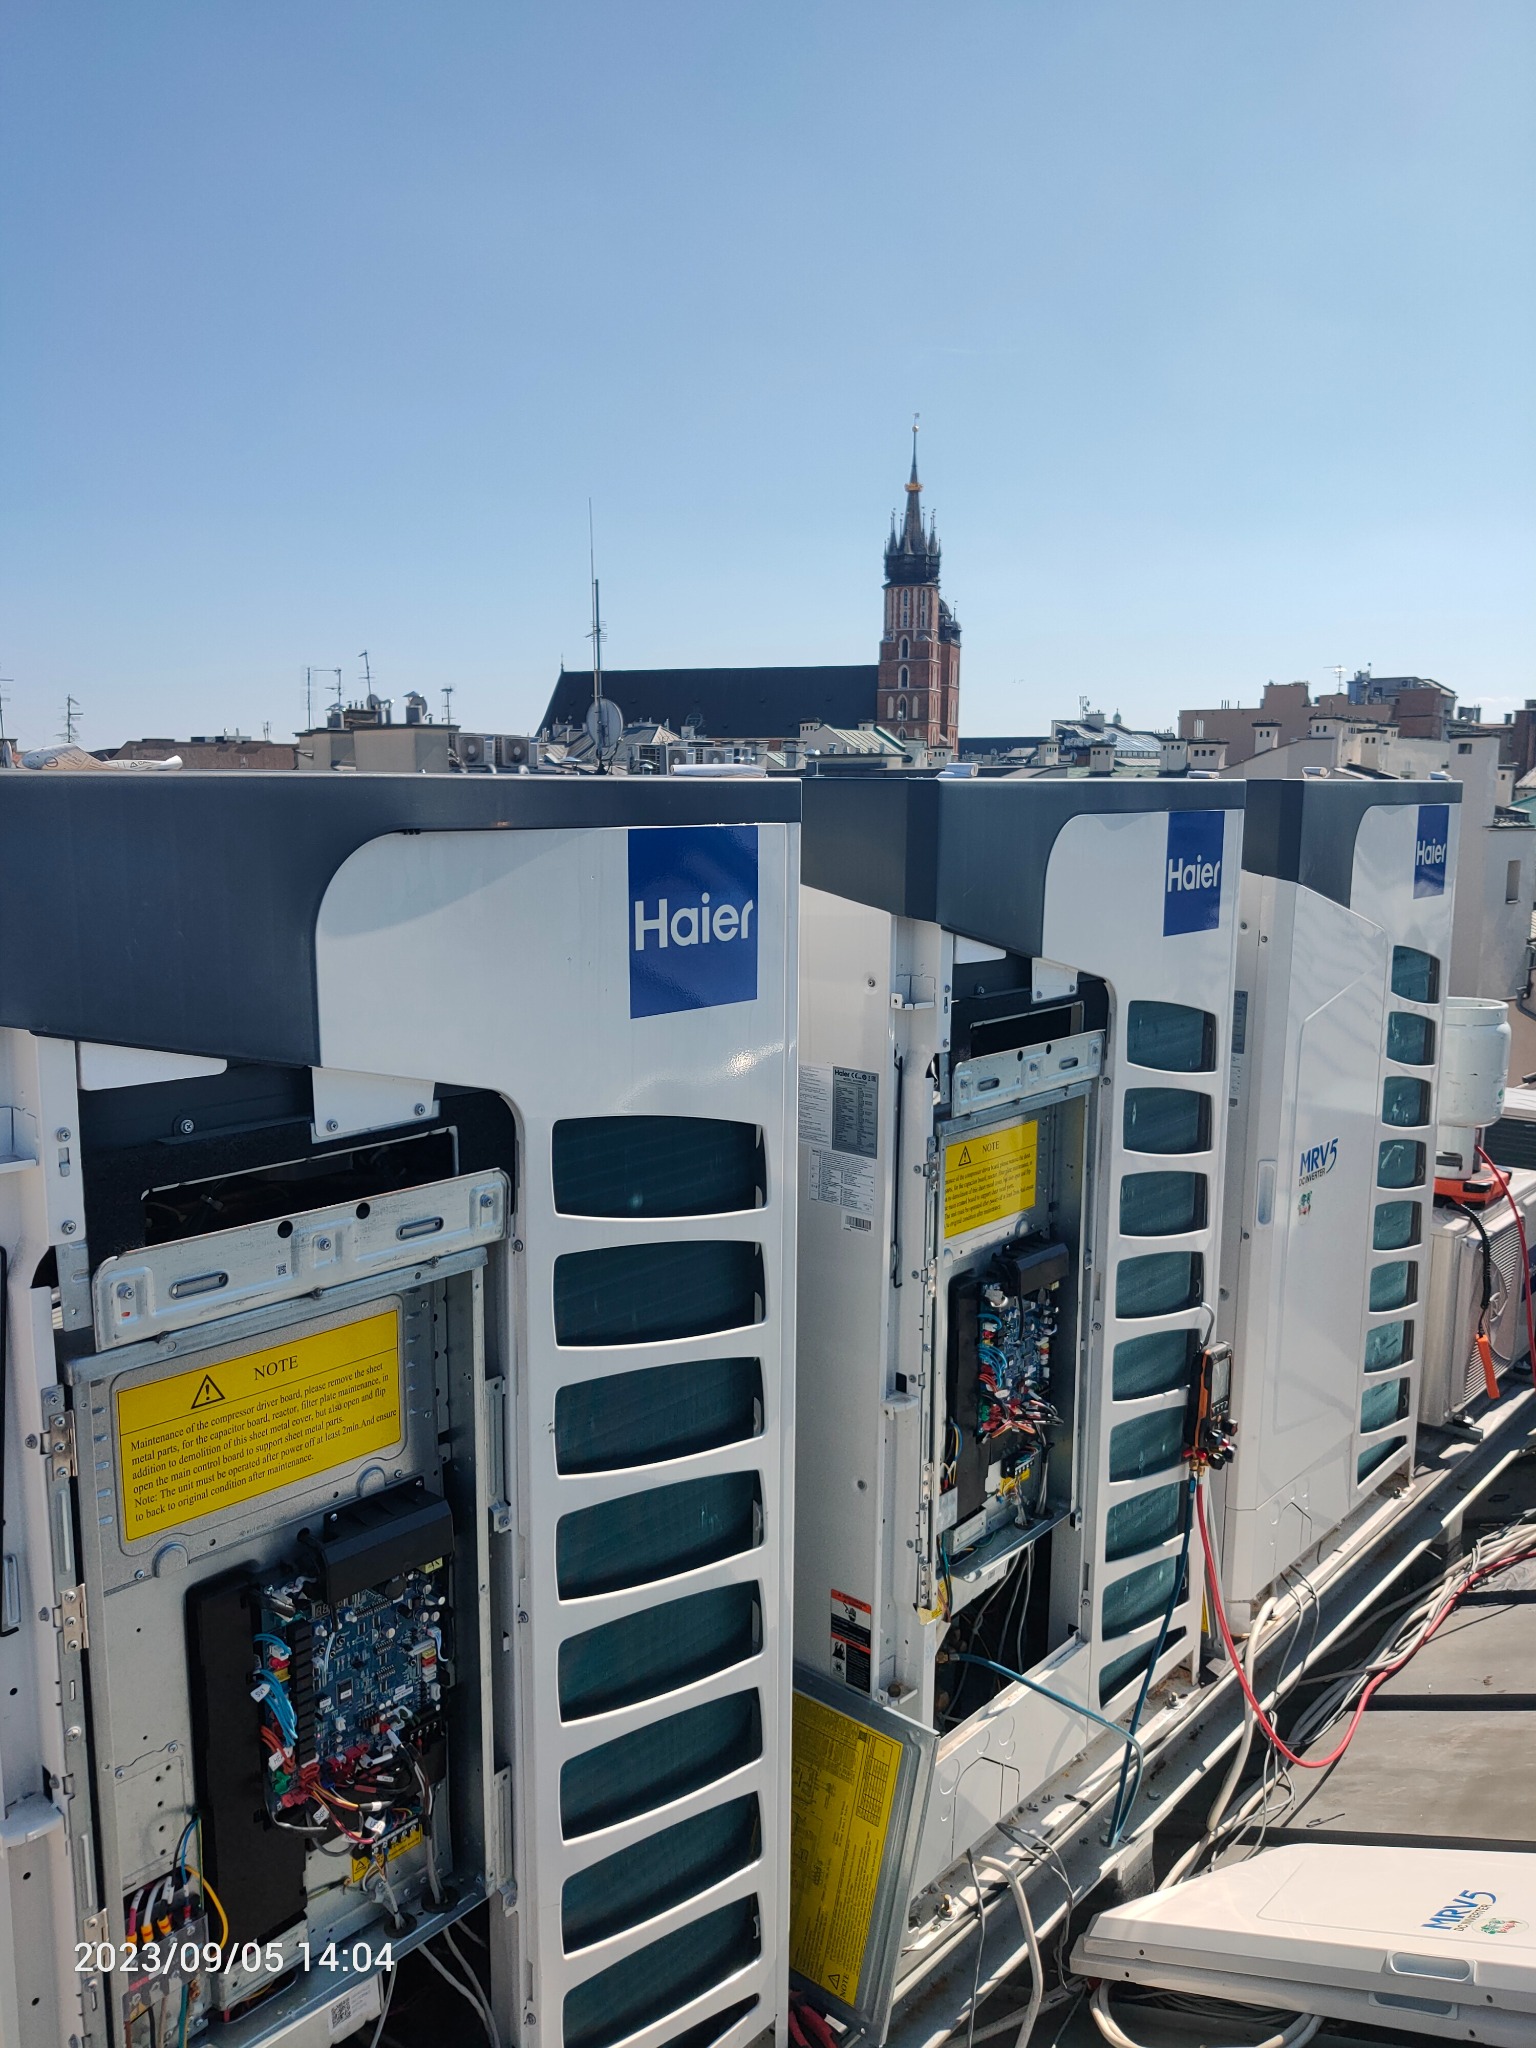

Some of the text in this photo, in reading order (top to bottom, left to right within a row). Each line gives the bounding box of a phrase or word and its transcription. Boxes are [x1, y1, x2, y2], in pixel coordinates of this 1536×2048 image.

[1415, 838, 1447, 866] Haier
[1167, 854, 1221, 892] Haier
[635, 892, 754, 951] Haier
[982, 1140, 1000, 1153] NOTE
[1299, 1138, 1338, 1176] MRV5
[1305, 1167, 1326, 1183] INVERTER
[253, 1354, 299, 1380] NOTE
[130, 1363, 383, 1451] Maintenance of the compressor driver board, please remove the sheet
[131, 1449, 155, 1465] metal
[157, 1445, 180, 1460] parts,
[182, 1439, 194, 1449] for
[195, 1434, 208, 1445] the
[209, 1423, 246, 1440] capacitor
[246, 1412, 271, 1428] board,
[272, 1405, 300, 1420] reactor,
[301, 1398, 319, 1409] filter
[319, 1392, 337, 1406] plate
[337, 1377, 381, 1397] maintenance,
[132, 1387, 386, 1479] addition to demolition of this sheet metal cover, but also open and flip
[133, 1416, 343, 1494] open the main control board to support sheet metal parts.
[134, 1494, 158, 1507] Note:
[159, 1487, 176, 1498] The
[178, 1480, 194, 1493] unit
[195, 1474, 215, 1487] must
[216, 1470, 227, 1479] be
[227, 1456, 261, 1476] operated
[262, 1452, 279, 1463] after
[280, 1443, 304, 1459] power
[304, 1436, 316, 1448] off
[316, 1435, 323, 1444] at
[325, 1429, 341, 1441] least
[375, 1409, 397, 1422] ensure
[135, 1454, 314, 1521] to back to original condition after maintenance.
[1420, 1889, 1497, 1930] MRV5
[1464, 1903, 1493, 1926] INVERTER
[839, 1973, 850, 1998] NOTE
